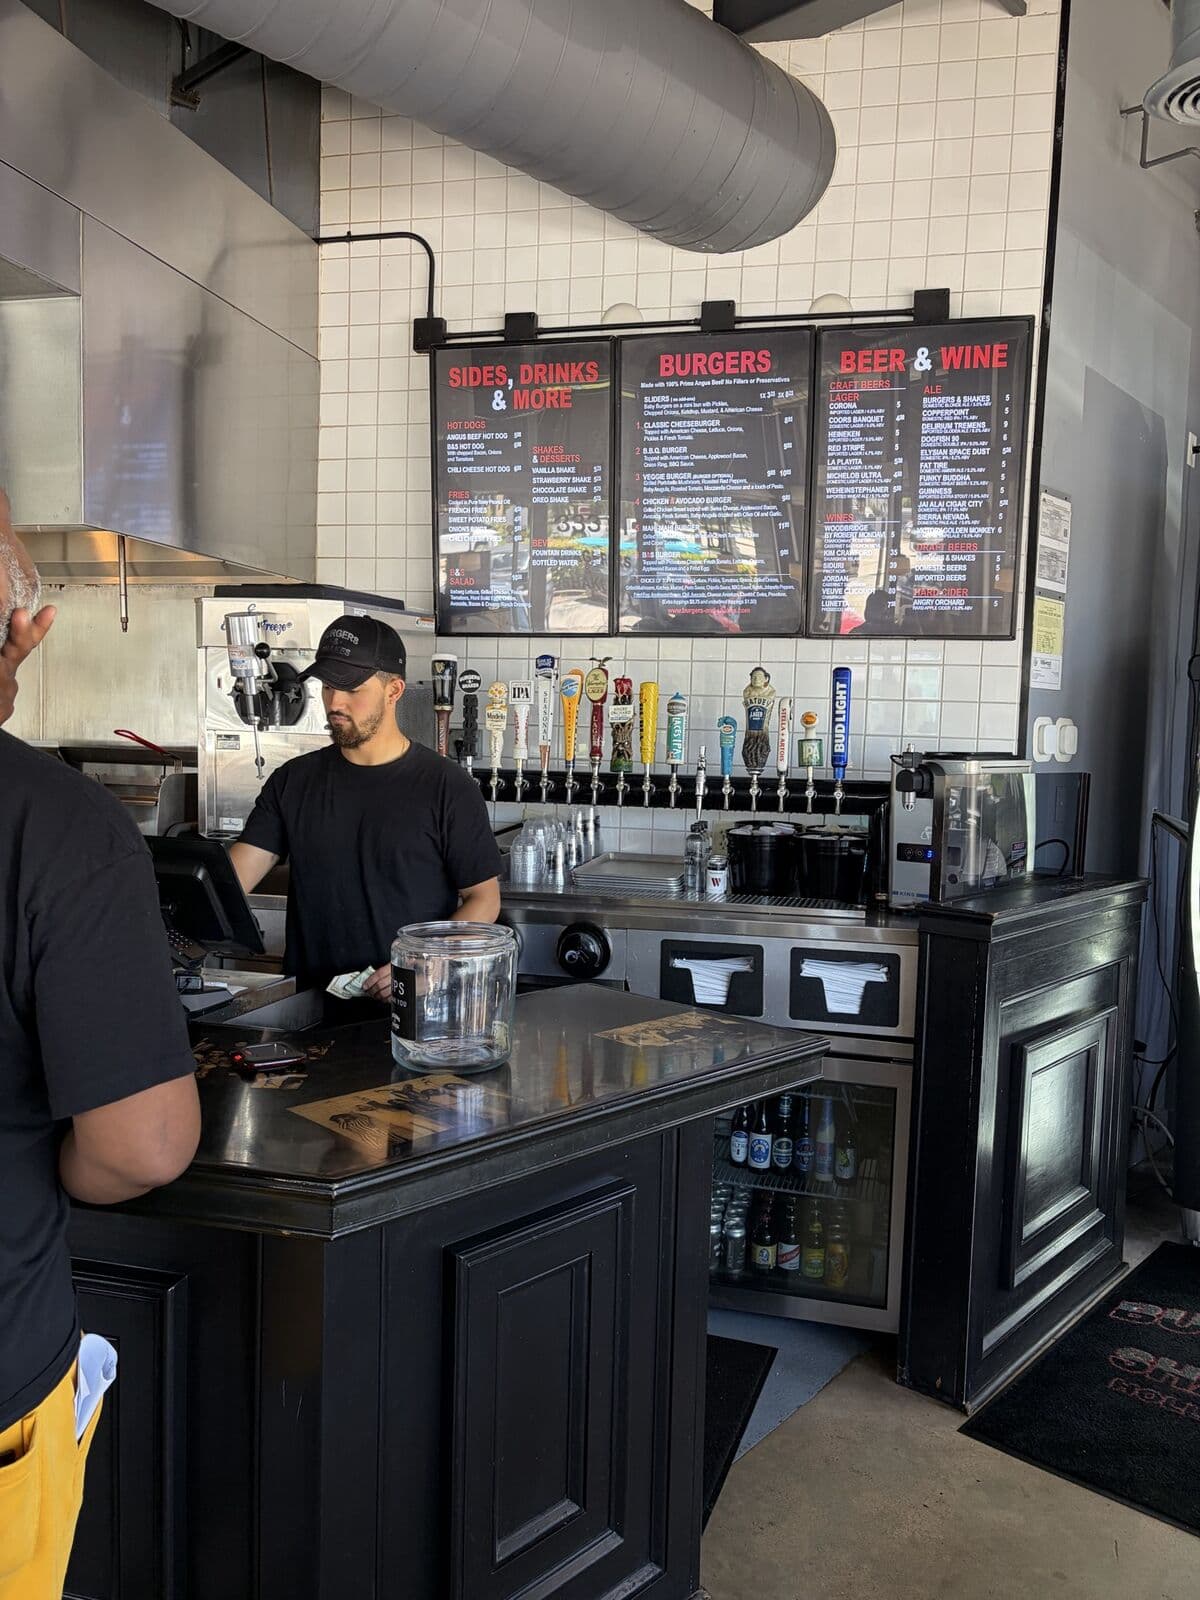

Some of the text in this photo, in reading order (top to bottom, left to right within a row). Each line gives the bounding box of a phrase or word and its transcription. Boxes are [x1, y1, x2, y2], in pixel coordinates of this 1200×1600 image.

[659, 349, 772, 377] BURGERS
[839, 343, 1009, 374] BEER & WINE
[448, 361, 599, 390] SIDES, DRINKS
[829, 379, 891, 390] CRAFT BEERS
[923, 385, 943, 394] ALE
[492, 387, 573, 410] & MORE
[644, 395, 669, 403] SLIDERS
[830, 392, 860, 402] LAGER
[922, 395, 955, 404] BURGERS
[1005, 394, 1010, 402] 5
[829, 400, 901, 410] CORONA 5
[922, 407, 1009, 416] COPPERPOINT 5
[643, 419, 721, 429] CLASSIC CHEESEBURGER
[828, 415, 884, 424] COORS BANQUET
[447, 420, 486, 430] HOT DOGS
[921, 420, 1009, 430] DELIRIUM TREMENS 9
[828, 430, 860, 438] HEINEKEN
[532, 445, 564, 454] SHAKES
[634, 447, 640, 455] 2
[661, 446, 688, 454] BURGER
[827, 444, 841, 452] RED
[894, 443, 899, 451] 5
[972, 447, 991, 455] DUST
[532, 454, 581, 463] & DESSERTS
[1001, 460, 1006, 468] 5
[531, 466, 556, 474] VANILLA
[665, 472, 692, 480] BURGER
[919, 474, 942, 482] FUNKY
[448, 490, 470, 499] FRIES
[918, 486, 1005, 495] GUINNESS 5
[705, 496, 732, 504] BURGER
[825, 513, 854, 522] WINES
[917, 513, 942, 521] SIERRA
[998, 512, 1003, 520] 5
[969, 526, 996, 534] MONKEY
[916, 542, 978, 551] DRAFT BEERS
[824, 549, 835, 557] KIM
[449, 577, 475, 586] SALAD
[914, 574, 945, 582] IMPORTED
[995, 574, 1000, 582] 6
[913, 588, 968, 596] HARD CIDER
[935, 598, 965, 606] ORCHARD
[512, 687, 530, 699] IPA
[486, 712, 506, 720] Modelo
[834, 681, 847, 753] BUD LIGHT
[672, 739, 682, 758] IPA
[803, 741, 820, 757] IPA
[711, 877, 721, 887] W
